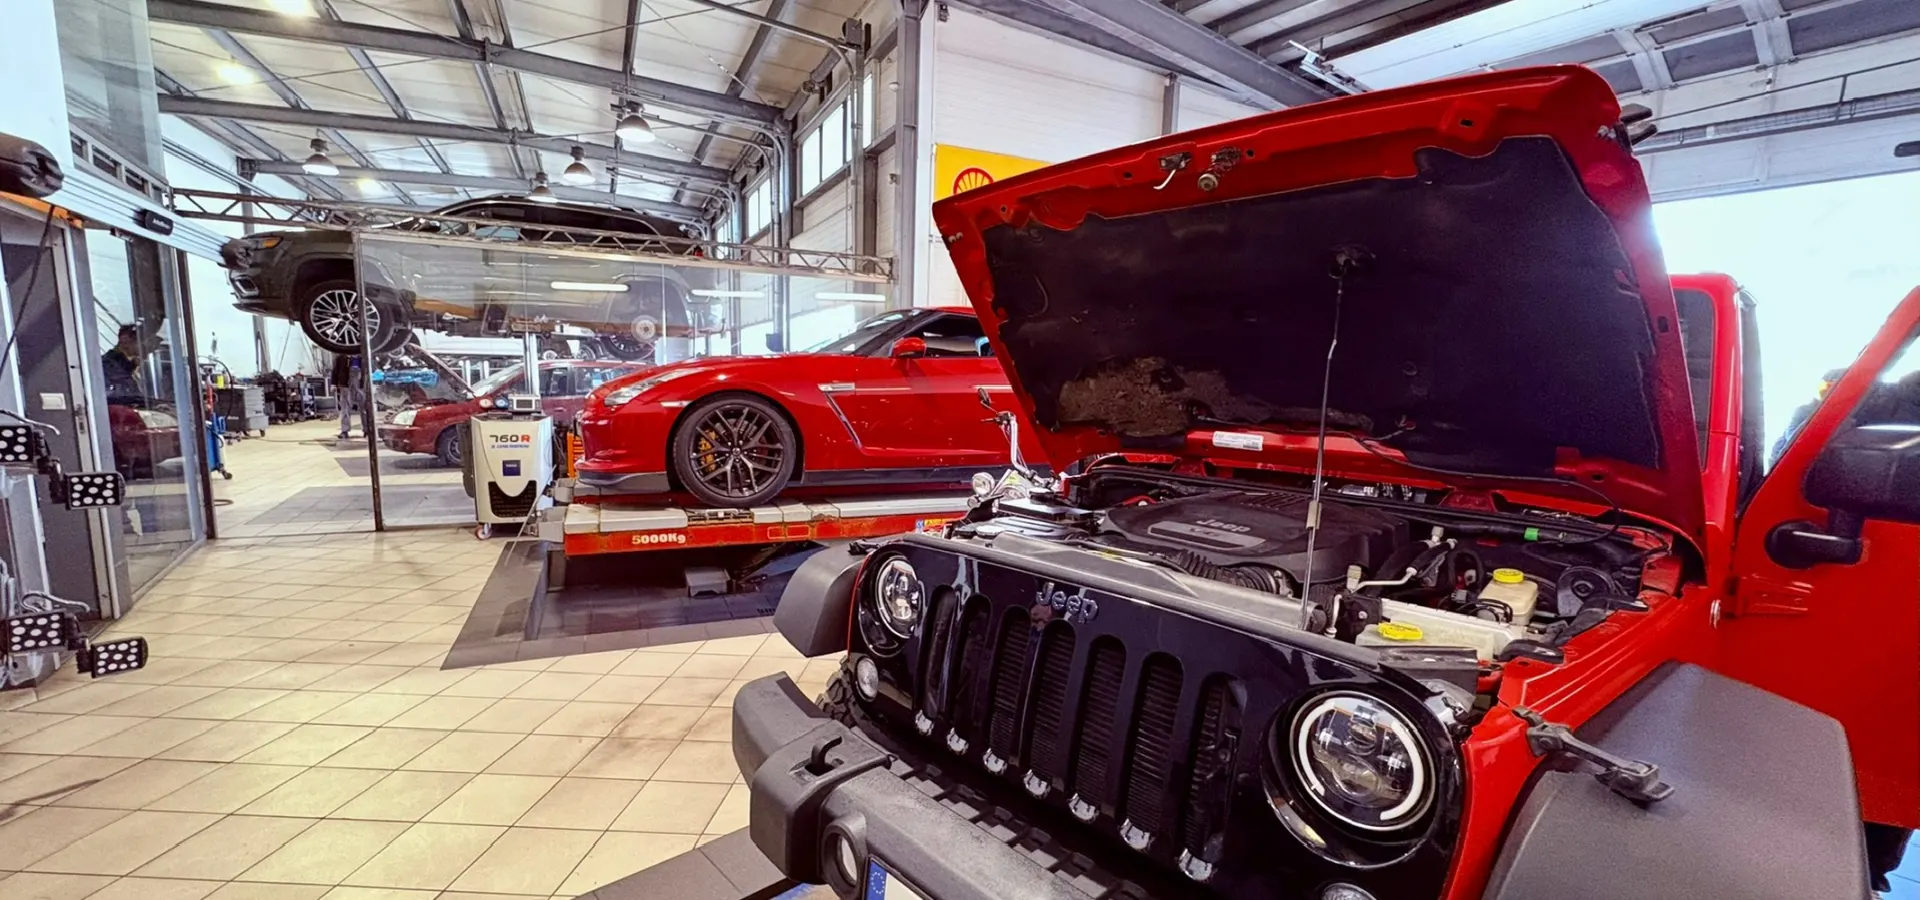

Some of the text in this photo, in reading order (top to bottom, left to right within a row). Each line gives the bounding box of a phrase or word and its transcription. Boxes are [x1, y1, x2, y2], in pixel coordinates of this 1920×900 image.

[1196, 519, 1251, 532] Jeep
[631, 532, 687, 545] 5000Kg
[1036, 581, 1099, 624] Jeep
